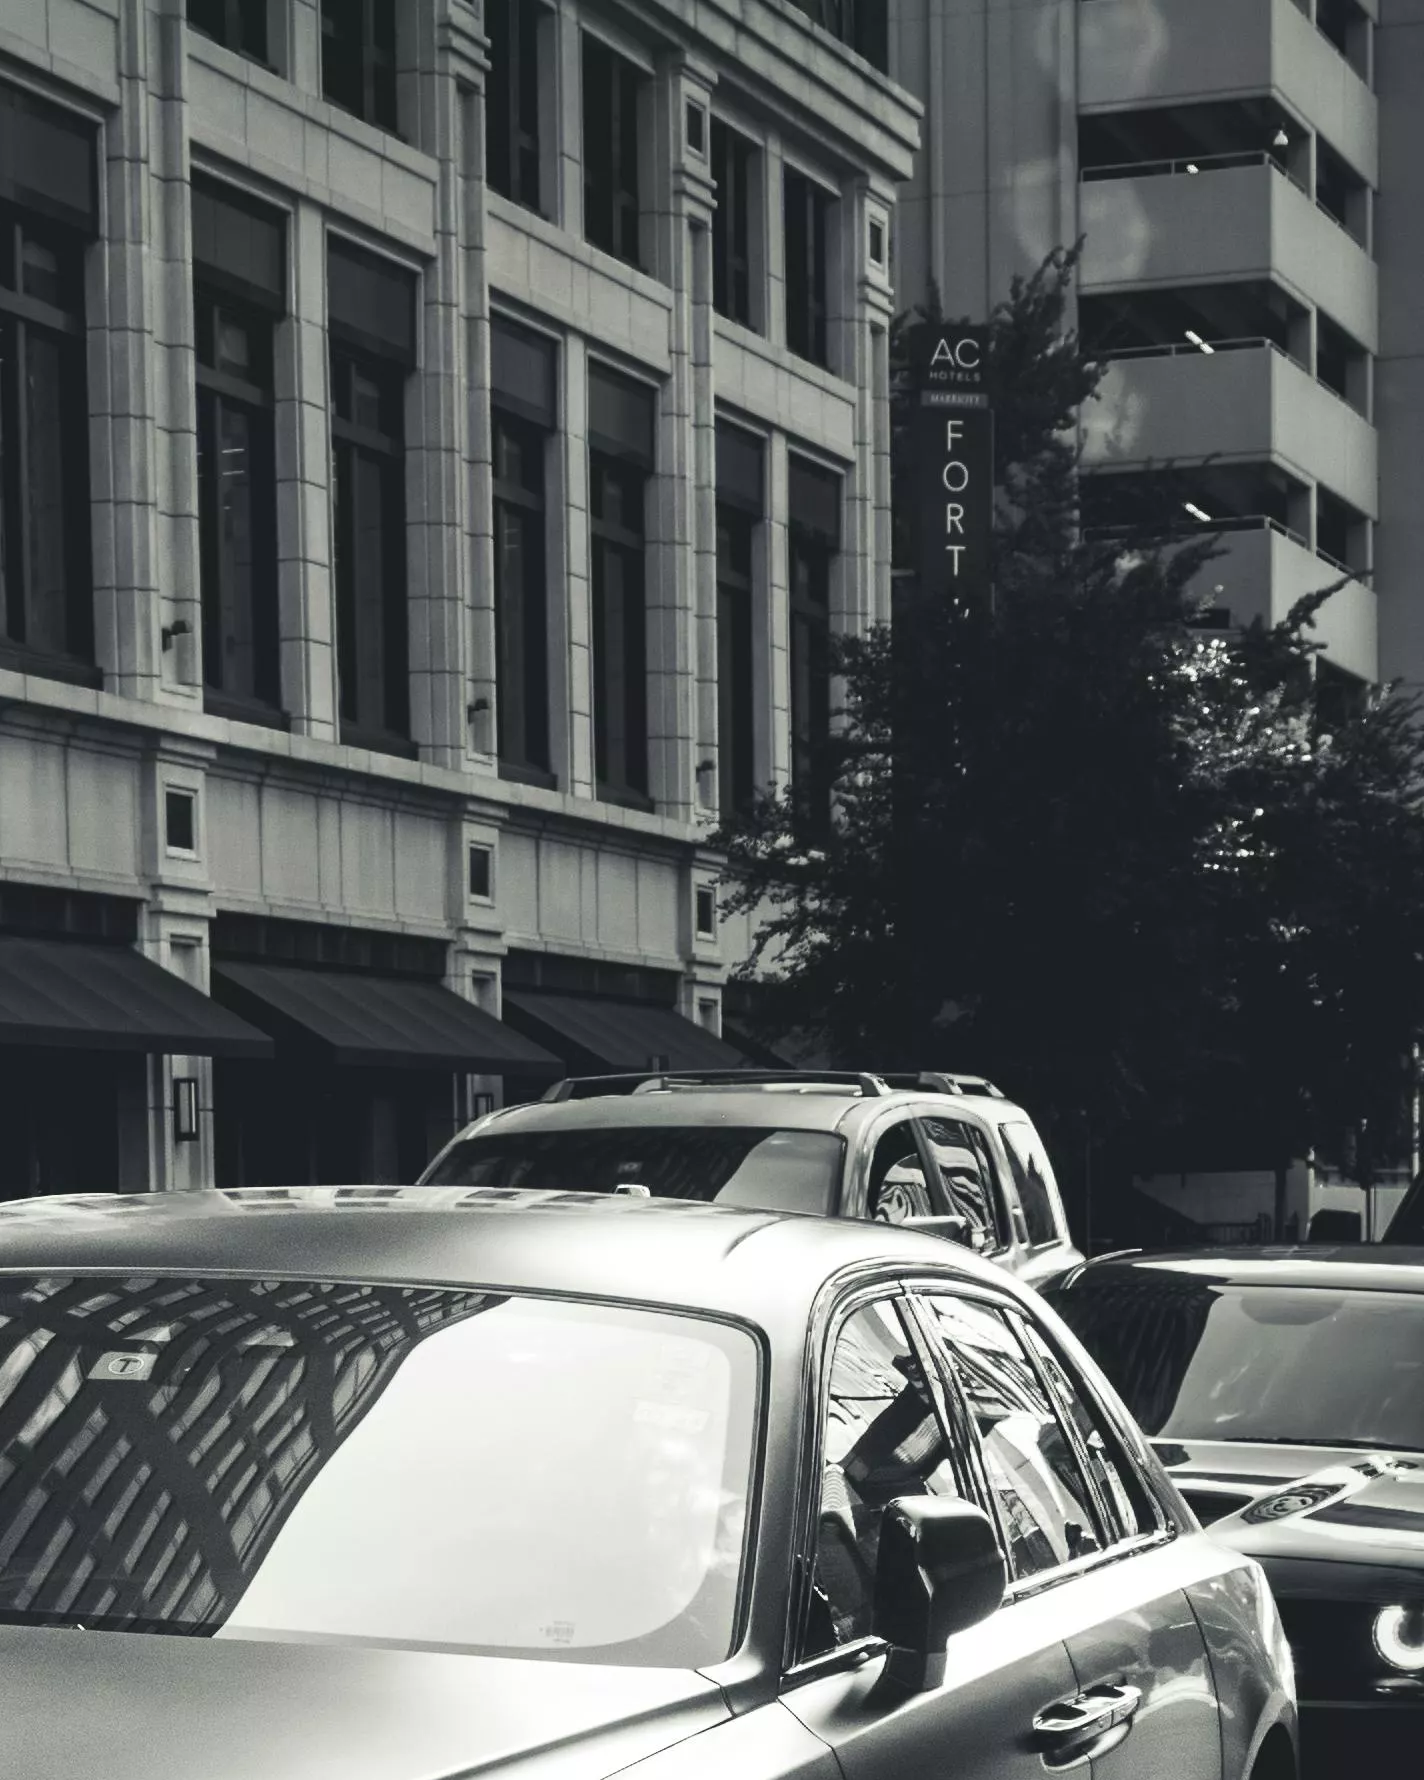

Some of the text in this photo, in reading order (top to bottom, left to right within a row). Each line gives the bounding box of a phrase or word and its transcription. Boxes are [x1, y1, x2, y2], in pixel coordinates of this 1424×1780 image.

[930, 338, 980, 368] AC
[929, 370, 981, 382] HOTELS
[942, 420, 969, 577] FORT
